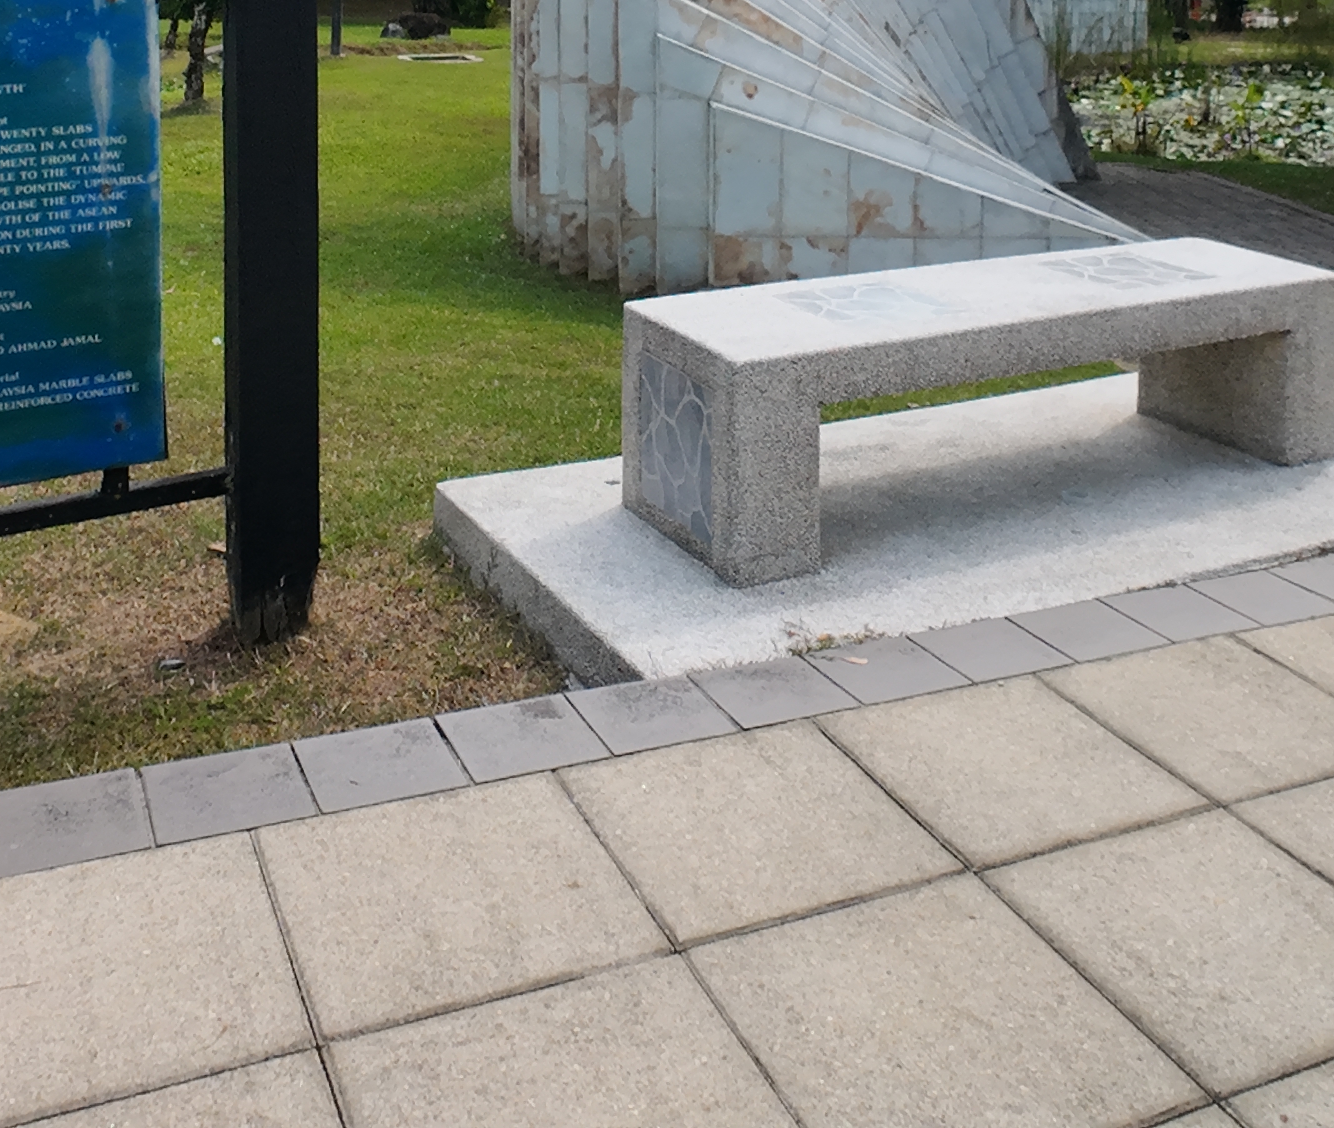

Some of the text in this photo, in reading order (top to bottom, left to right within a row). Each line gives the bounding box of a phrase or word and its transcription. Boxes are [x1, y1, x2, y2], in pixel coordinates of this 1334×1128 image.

[52, 124, 93, 135] SLABS
[40, 141, 54, 151] IN
[58, 140, 67, 149] A
[71, 135, 127, 148] CURVING
[41, 154, 77, 166] FROM
[81, 152, 90, 162] A
[94, 150, 121, 160] LOW
[19, 170, 38, 181] TO
[42, 167, 67, 178] THE
[41, 196, 66, 206] THE
[71, 191, 128, 204] DYNAMIC
[25, 212, 42, 223] OF
[46, 210, 72, 220] THE
[76, 205, 117, 217] ASEAN
[17, 224, 65, 239] DURING
[70, 222, 94, 233] THE
[99, 218, 133, 231] FIRST
[9, 340, 57, 354] AHMAD
[61, 333, 102, 347] JAMAL
[39, 376, 90, 392] MARBLE
[93, 370, 132, 384] SLABS
[77, 382, 140, 400] CONCRETE
